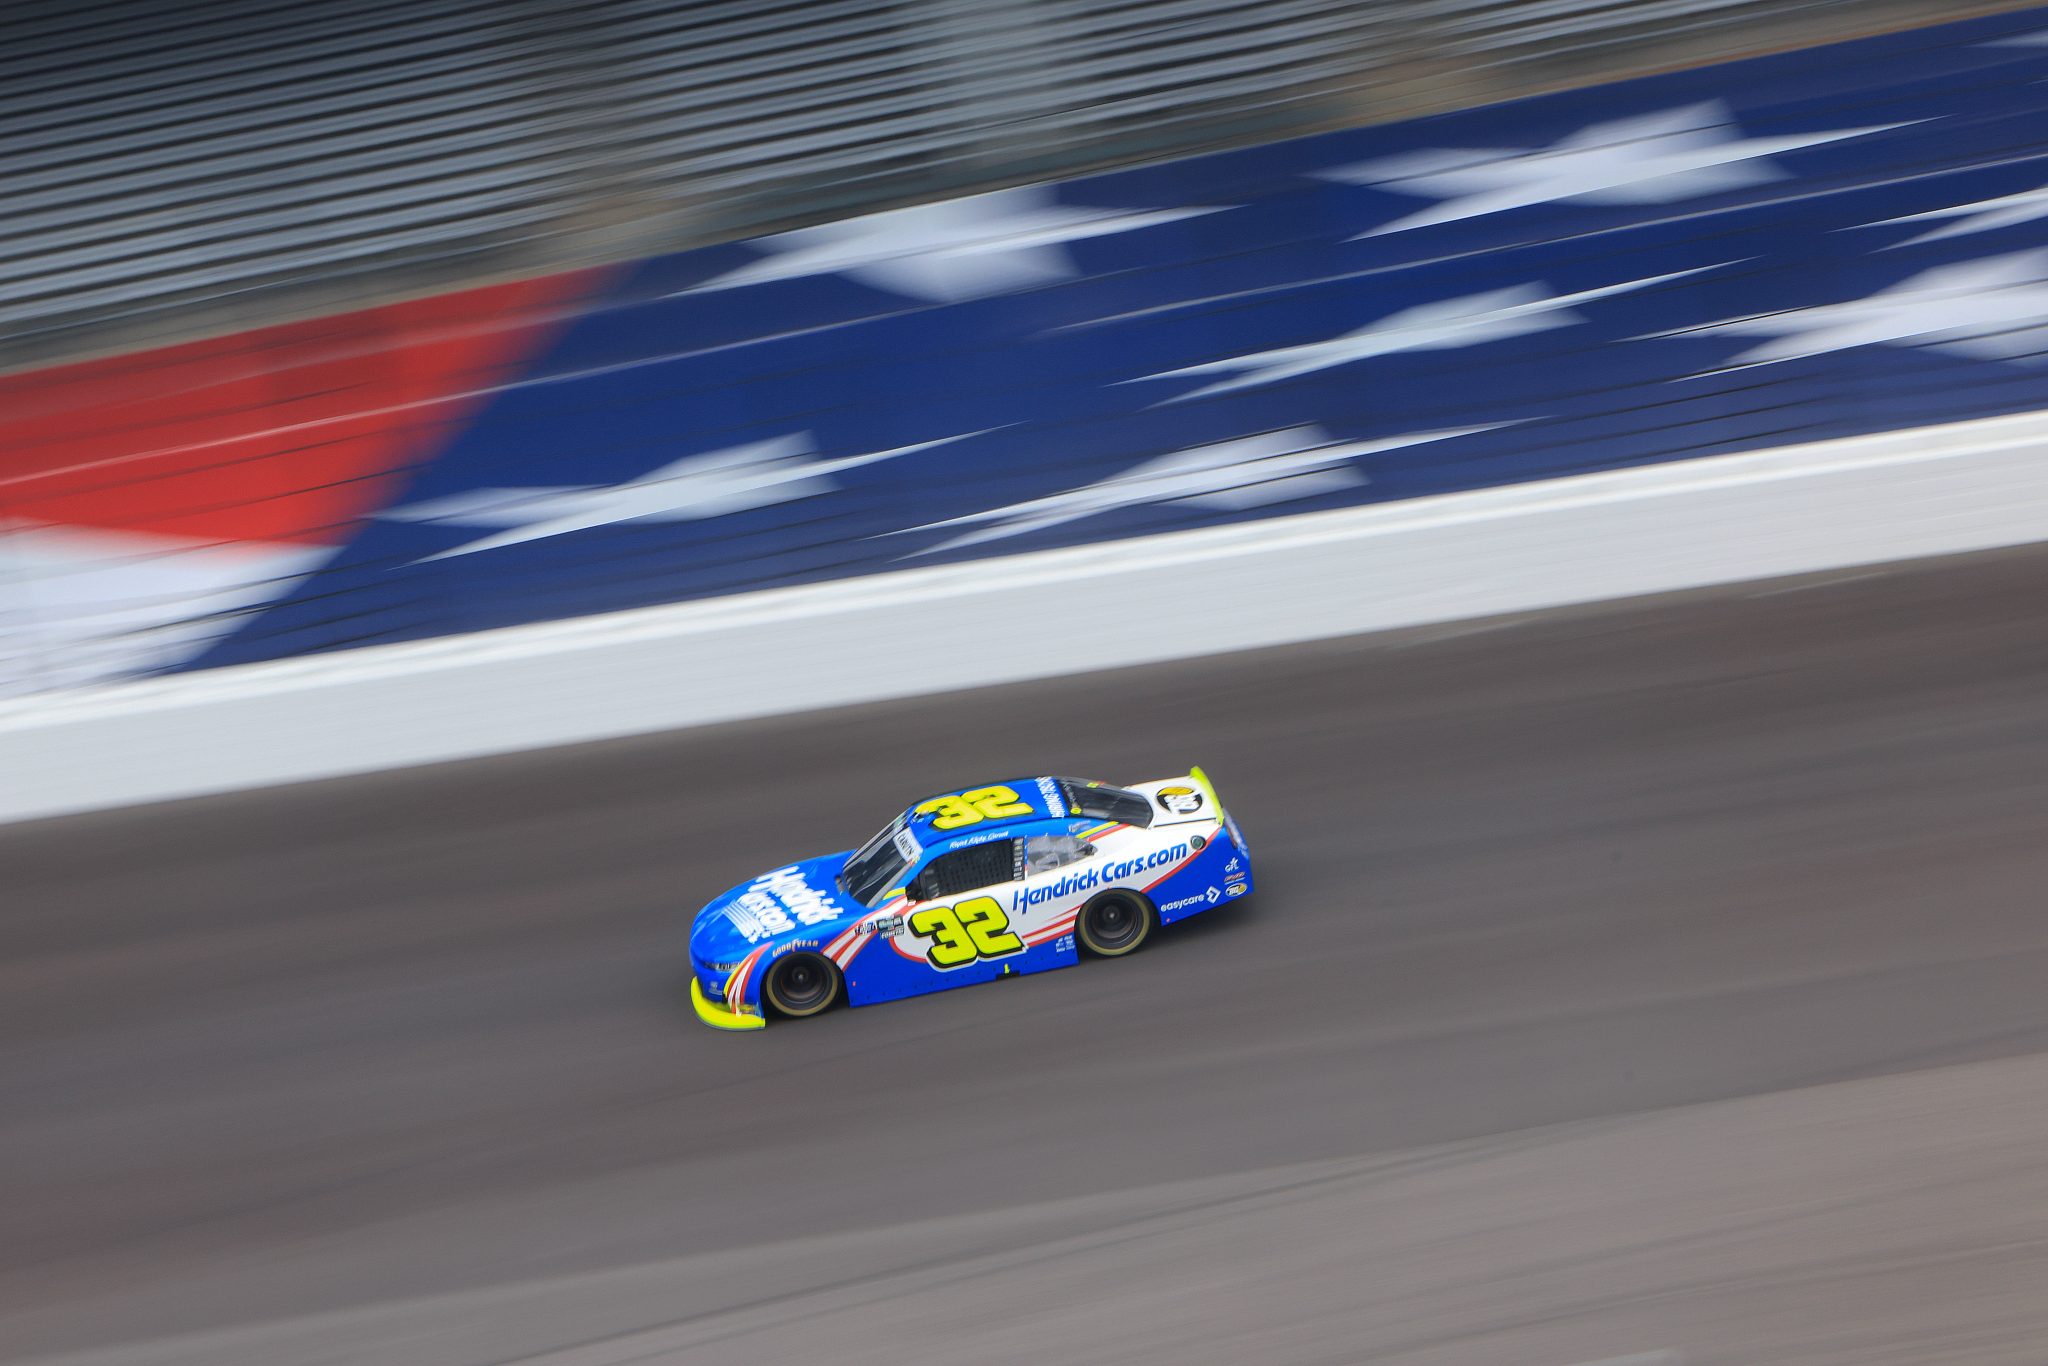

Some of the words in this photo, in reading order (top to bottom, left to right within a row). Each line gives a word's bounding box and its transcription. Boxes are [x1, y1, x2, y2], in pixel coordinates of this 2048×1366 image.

[913, 785, 1034, 830] 32
[1012, 868, 1099, 915] Hendrick
[1101, 843, 1187, 883] Cars.com
[1160, 894, 1205, 912] easycare
[772, 938, 818, 958] GOODYEAR
[908, 895, 1024, 969] 32
